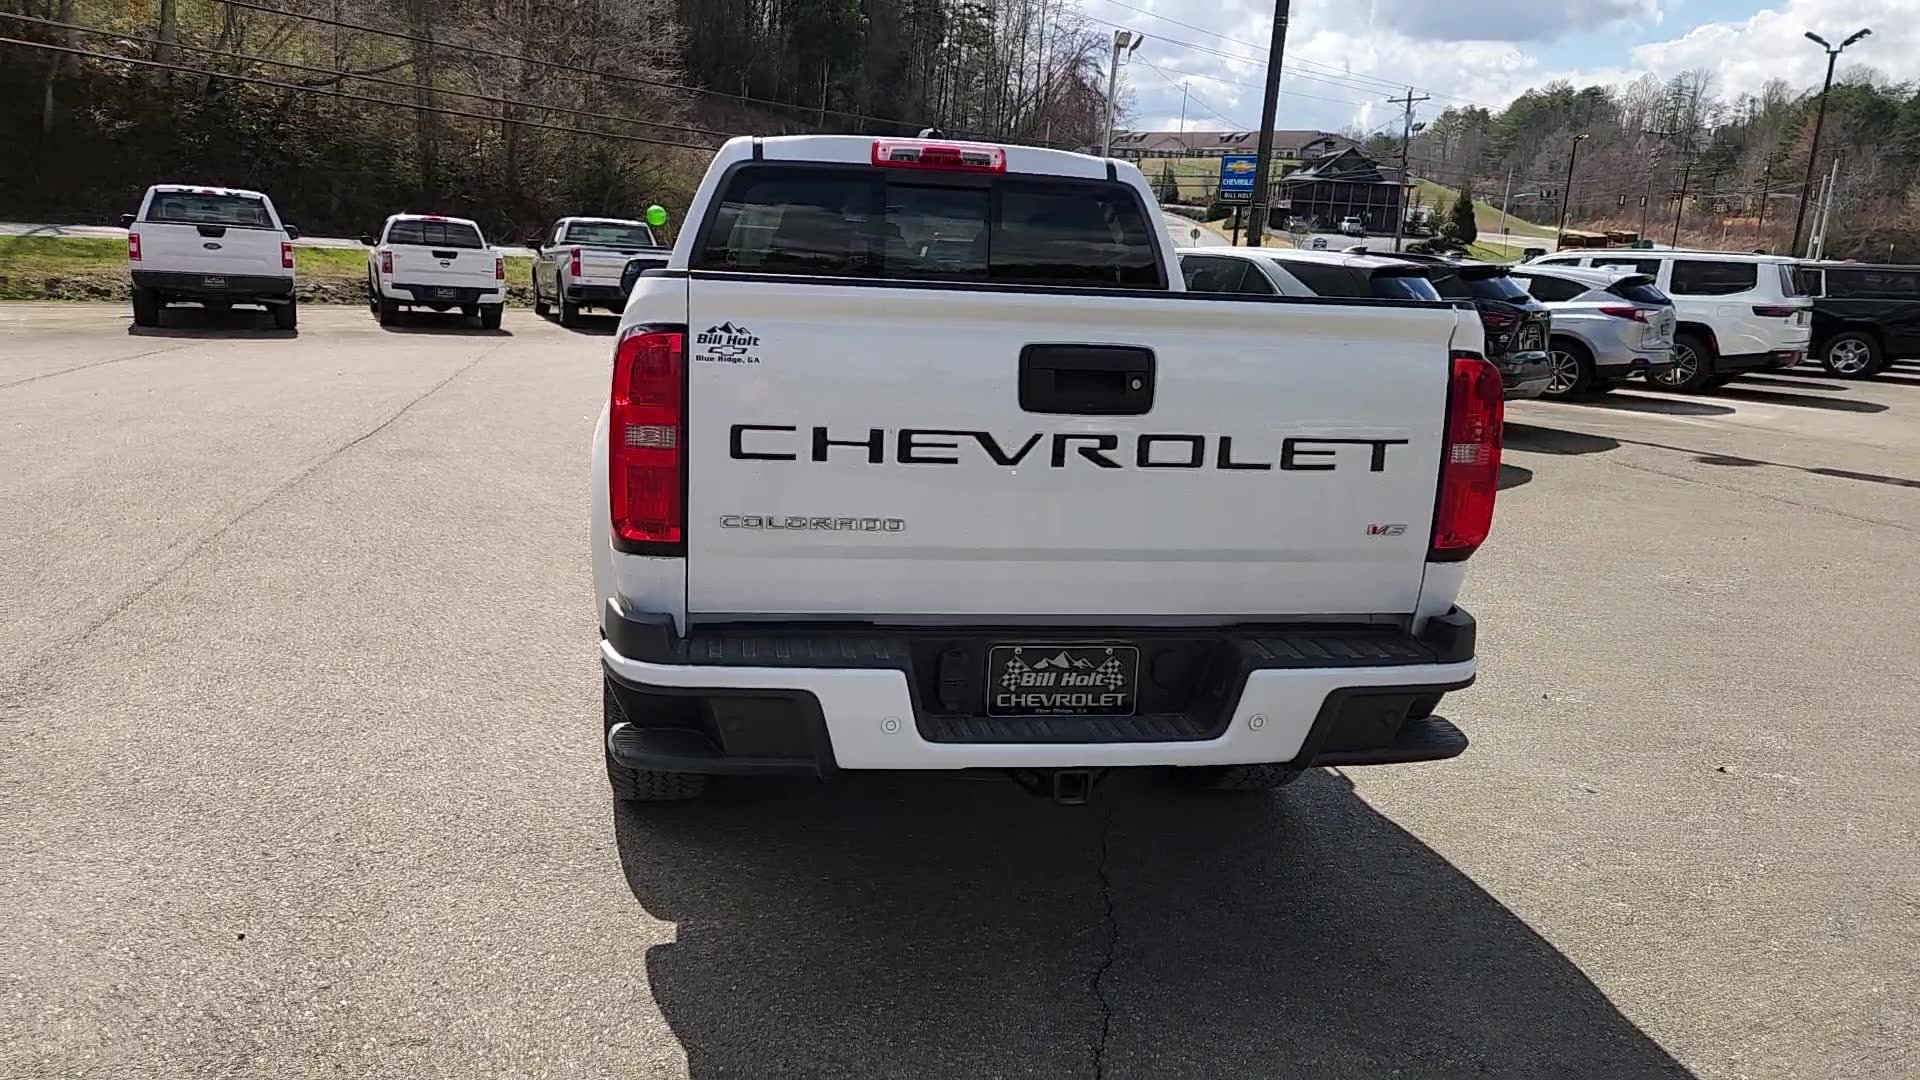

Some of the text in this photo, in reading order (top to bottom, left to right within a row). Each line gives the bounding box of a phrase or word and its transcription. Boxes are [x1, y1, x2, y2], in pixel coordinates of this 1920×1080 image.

[696, 334, 760, 346] Bill Holt
[718, 356, 745, 364] Ridge,
[730, 424, 1409, 472] CHEVROLET
[720, 515, 905, 532] COLORADO
[1366, 524, 1408, 536] V6
[1020, 672, 1106, 687] Bill Holt
[996, 694, 1127, 707] CHEVROLET
